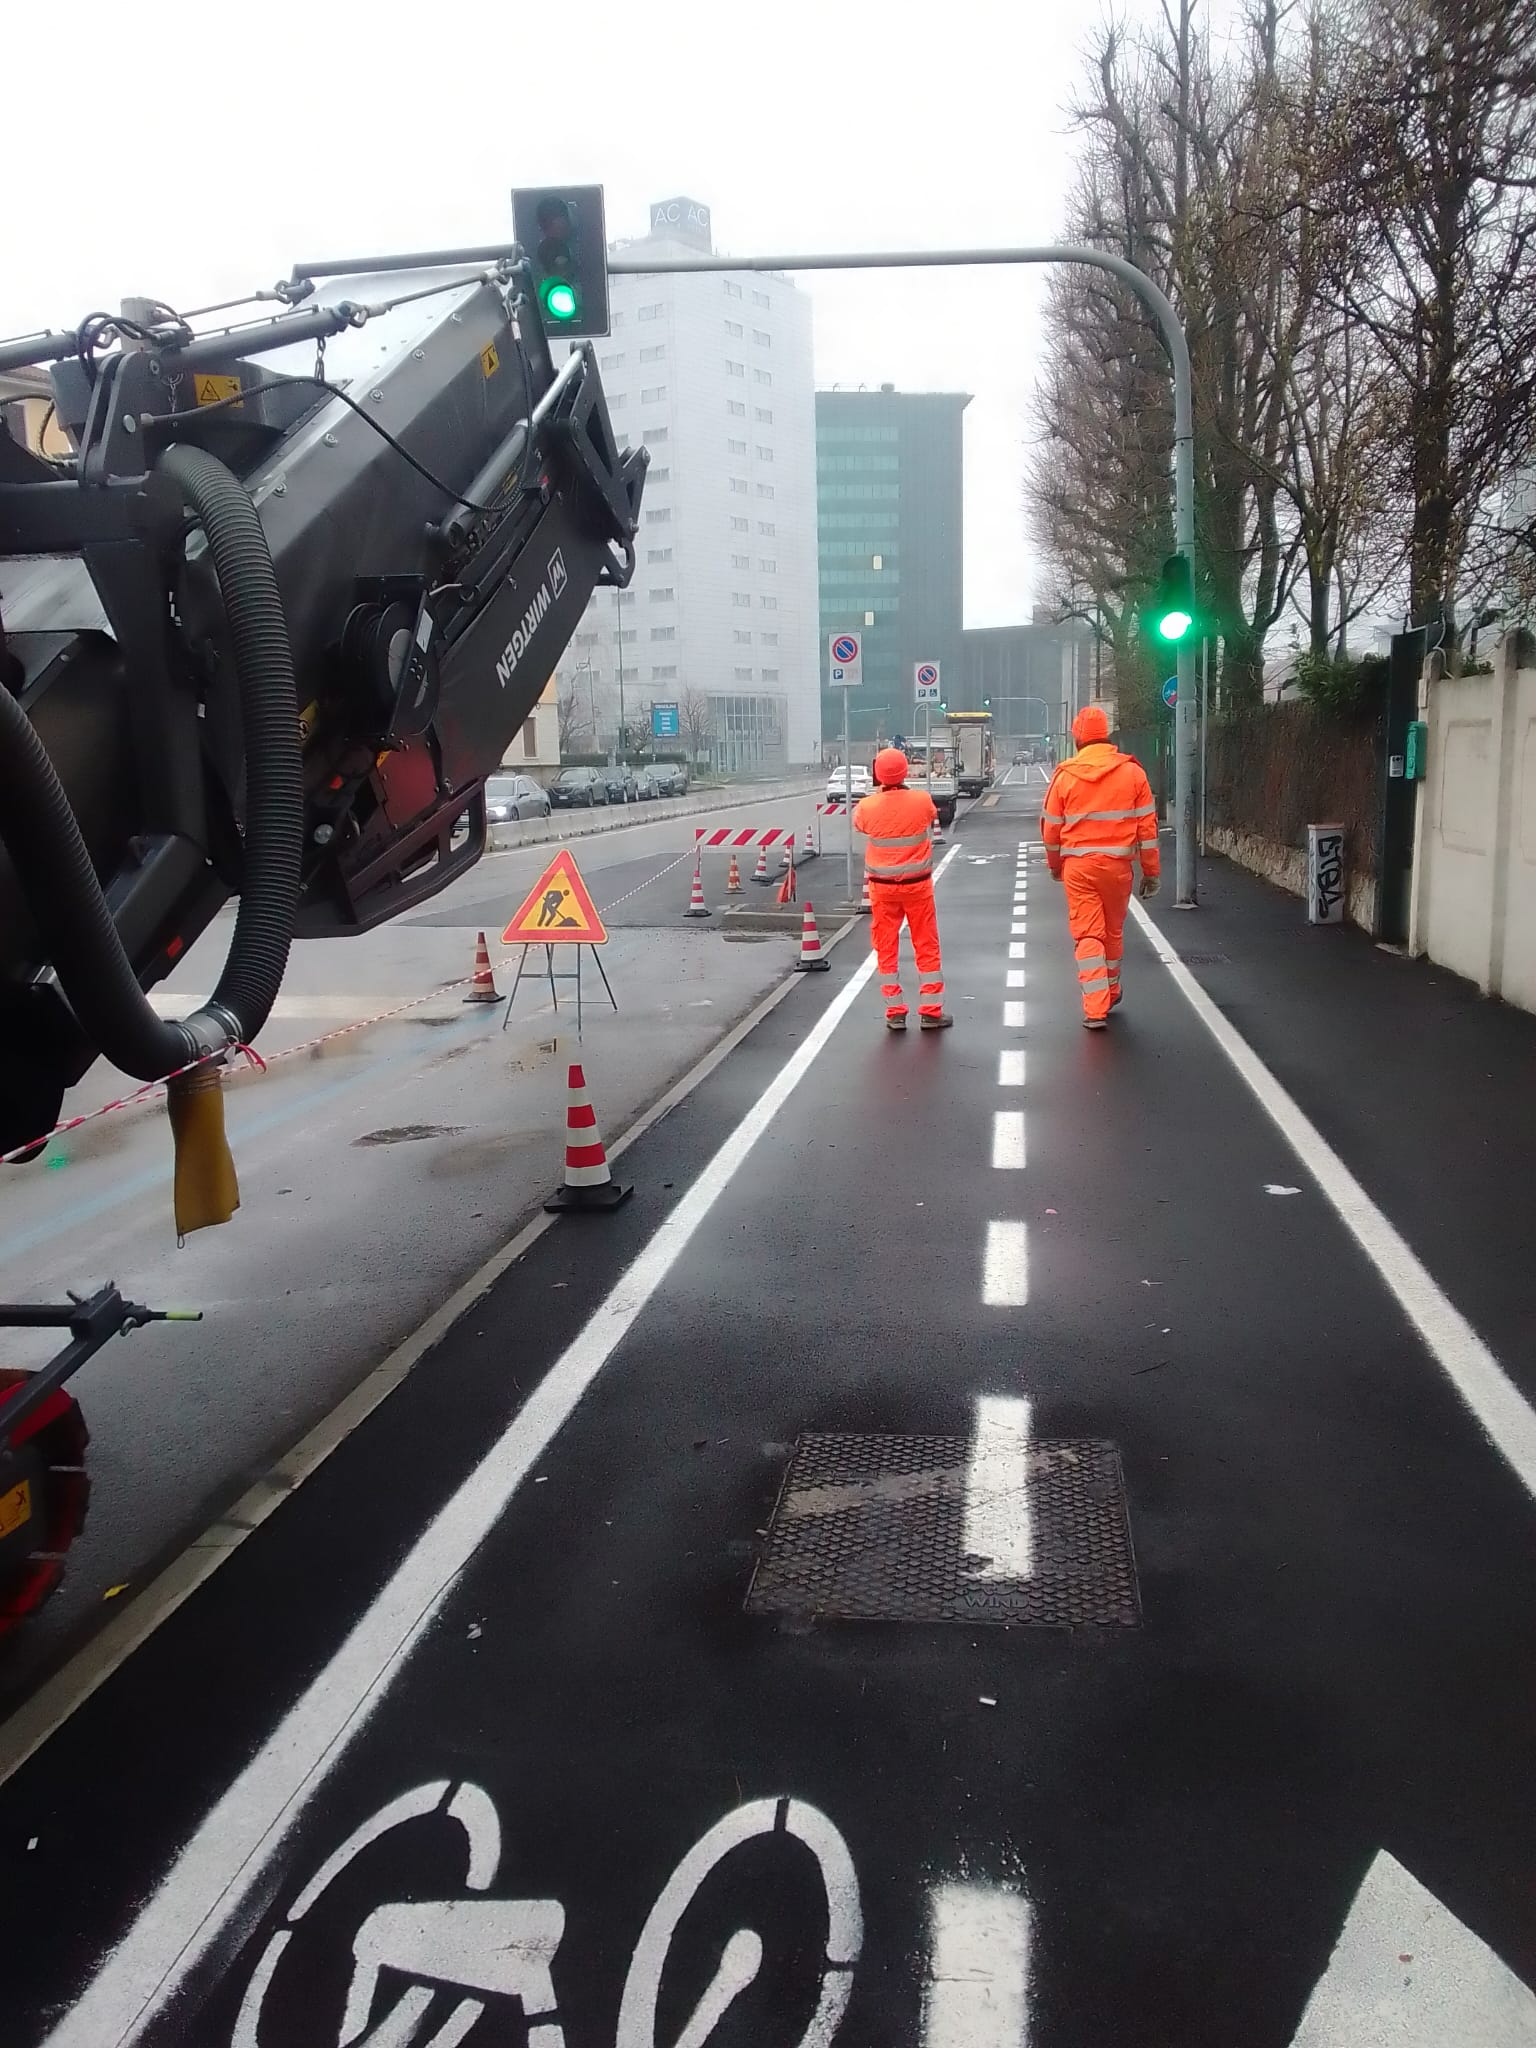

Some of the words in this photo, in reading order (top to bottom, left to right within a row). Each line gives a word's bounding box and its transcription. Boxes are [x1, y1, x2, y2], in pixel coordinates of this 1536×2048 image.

[654, 203, 681, 227] AC
[687, 205, 709, 227] AC
[495, 583, 552, 689] WIRTGEN
[834, 670, 842, 679] P
[964, 1595, 1030, 1609] WIND
